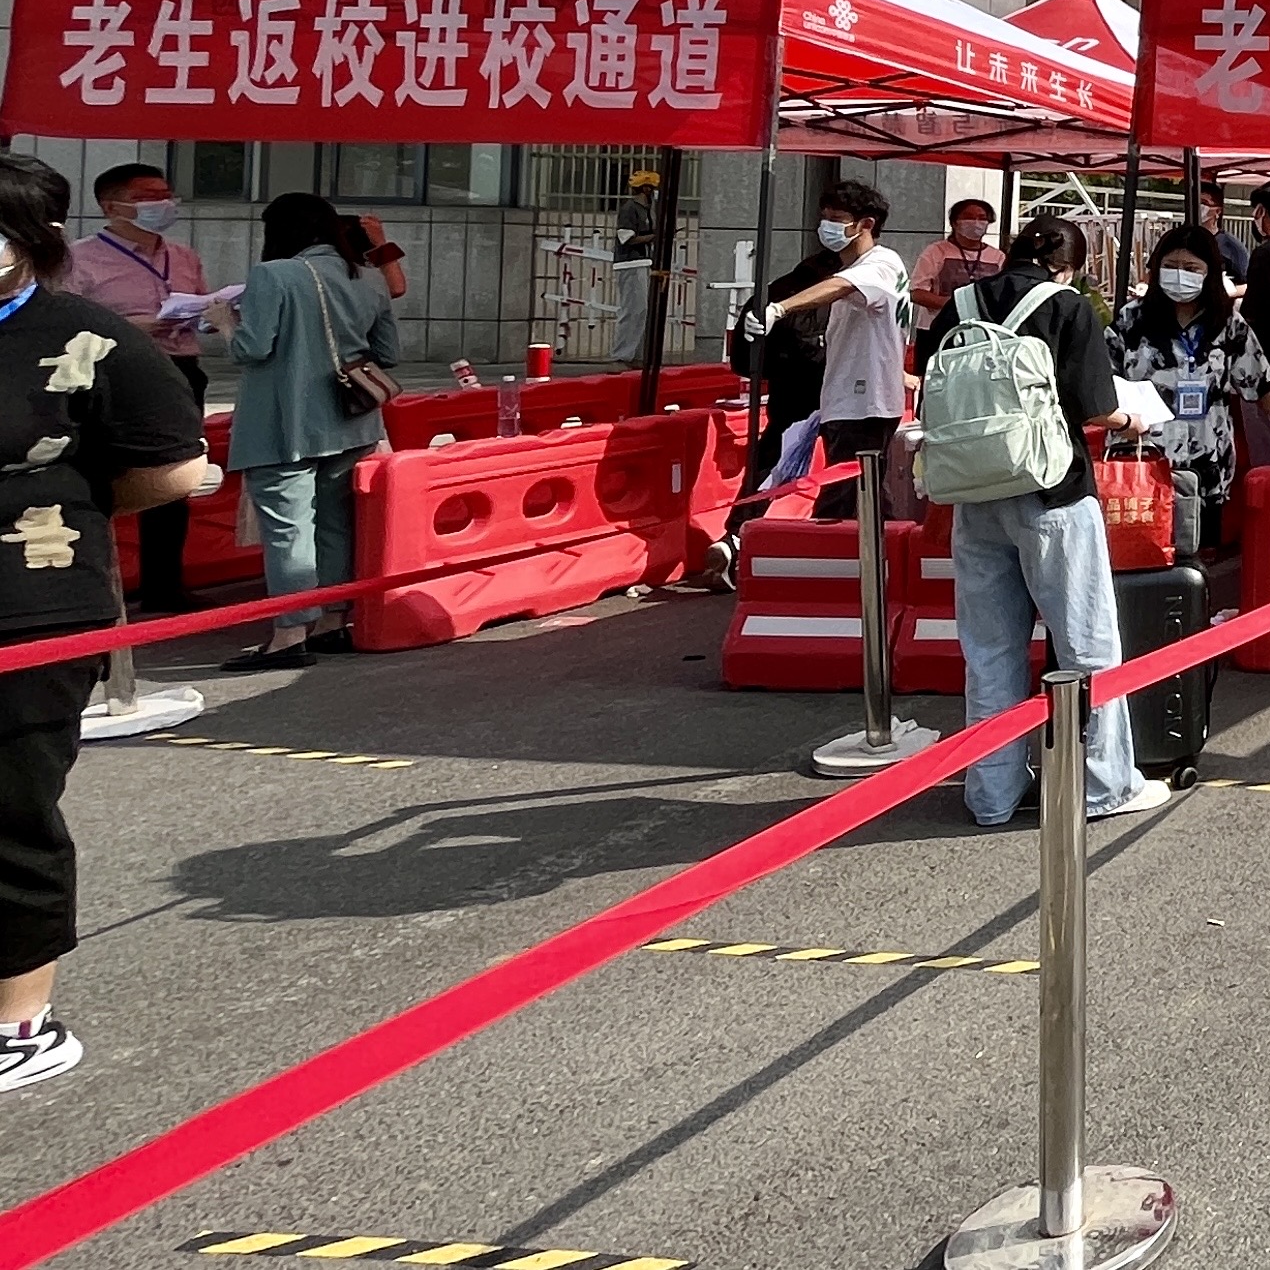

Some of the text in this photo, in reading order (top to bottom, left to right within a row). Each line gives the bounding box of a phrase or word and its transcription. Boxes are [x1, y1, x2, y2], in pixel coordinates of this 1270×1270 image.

[954, 39, 1095, 110] 让未来生长
